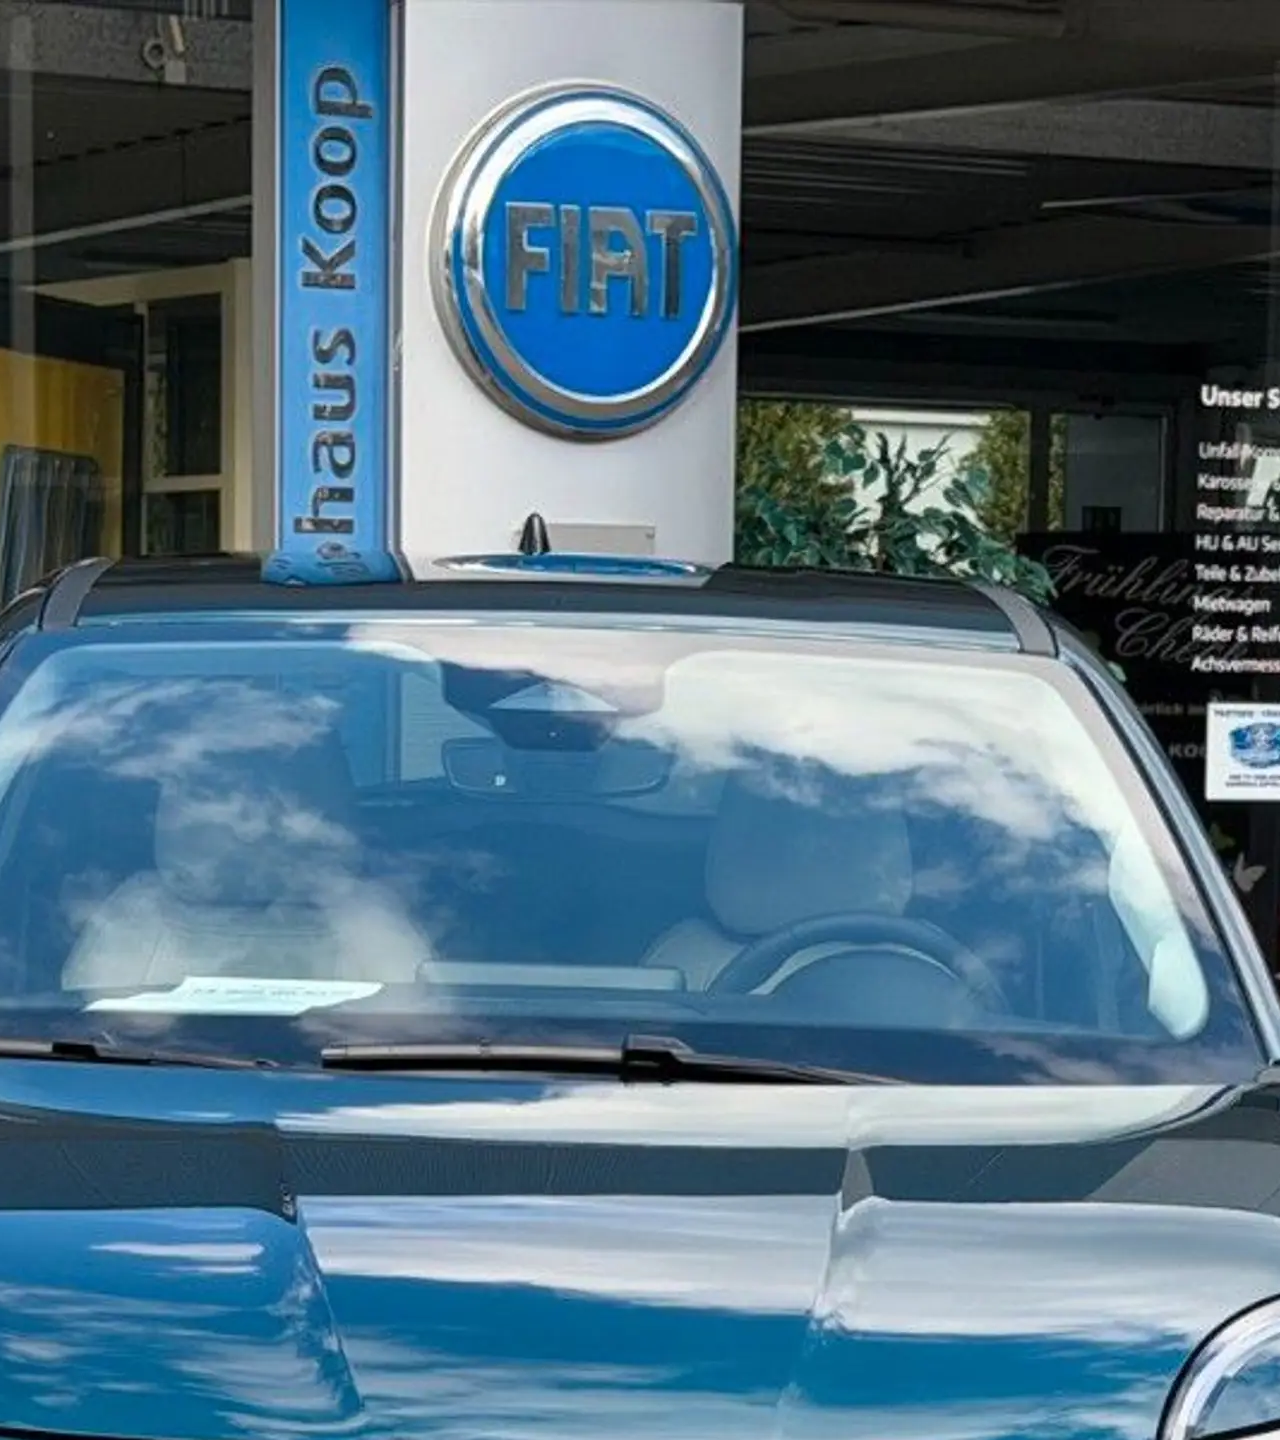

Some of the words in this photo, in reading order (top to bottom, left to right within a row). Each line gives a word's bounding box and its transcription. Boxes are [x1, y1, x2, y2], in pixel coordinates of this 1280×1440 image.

[300, 66, 373, 290] Koop
[505, 201, 697, 319] FIAT
[1200, 384, 1263, 409] Unser
[1196, 503, 1265, 524] Reparatur
[1195, 534, 1219, 550] HU
[1222, 534, 1234, 551] &
[1236, 534, 1258, 551] AU
[1194, 563, 1227, 582] Teile
[1229, 564, 1241, 582] &
[1192, 595, 1271, 616] Mietwagen
[1191, 624, 1233, 643] Räder
[1236, 625, 1248, 643] &
